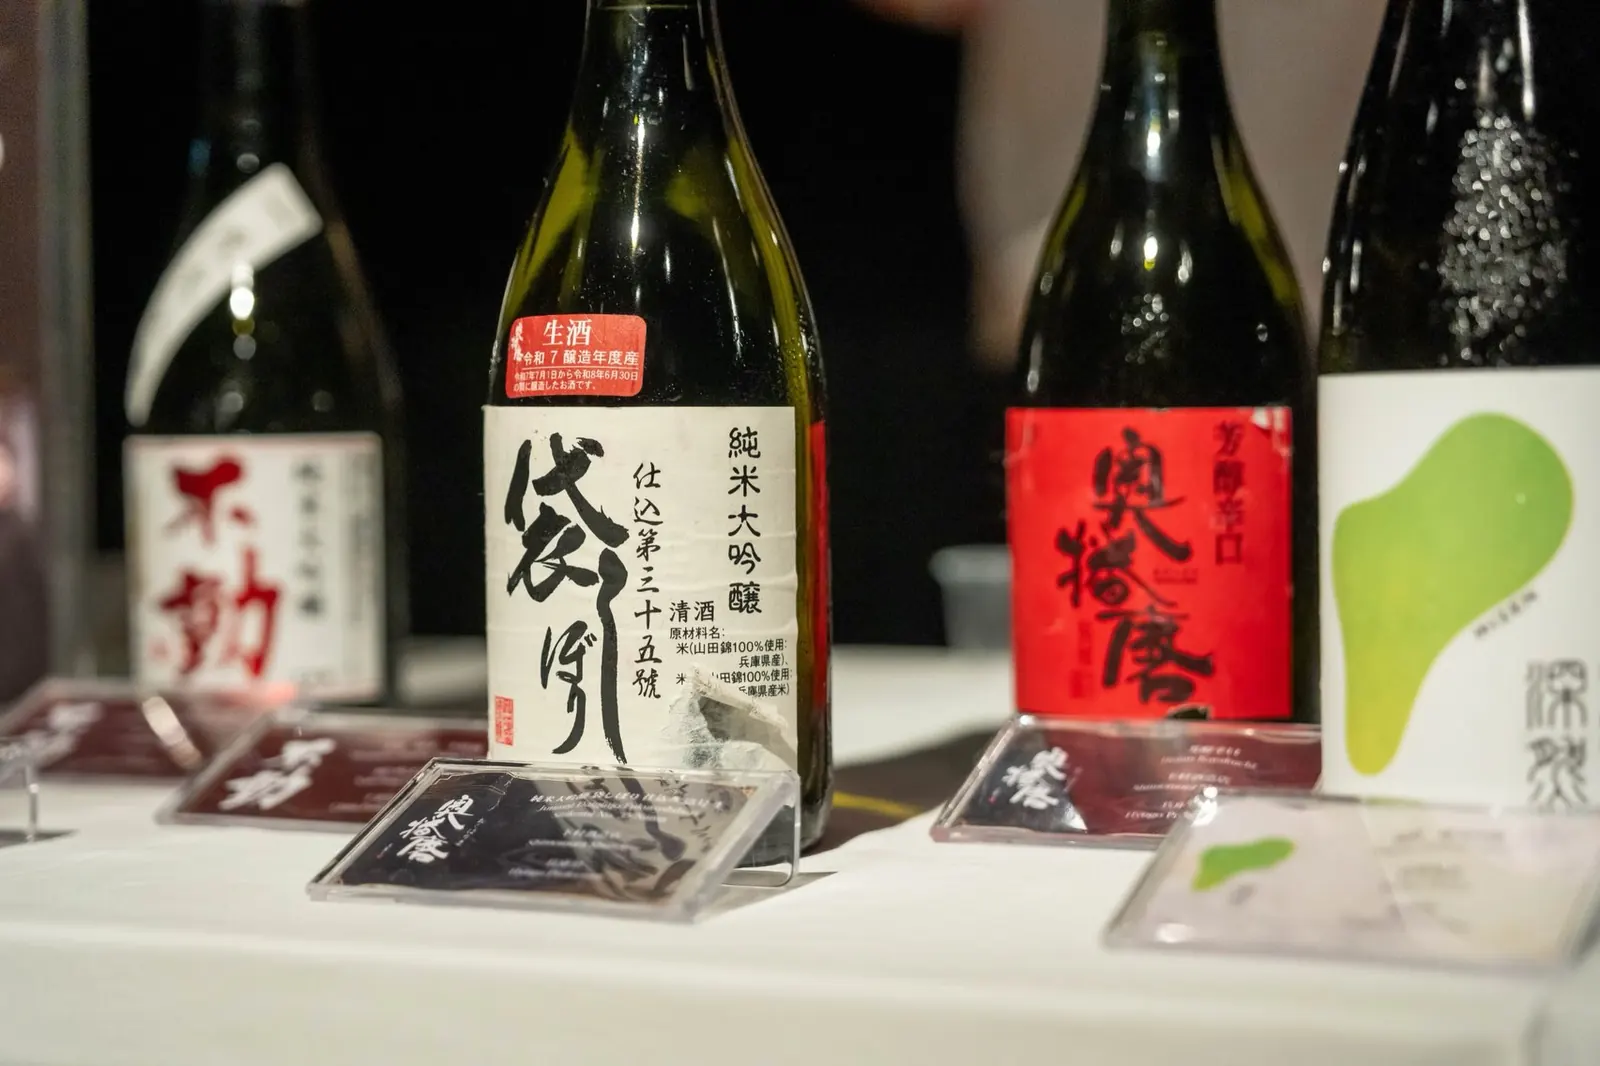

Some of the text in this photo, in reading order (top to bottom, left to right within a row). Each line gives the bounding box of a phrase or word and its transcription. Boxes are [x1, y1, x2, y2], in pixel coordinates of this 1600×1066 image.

[542, 319, 592, 346] 生酒
[728, 426, 762, 614] 純米大吟醸
[632, 462, 663, 699] 仕込第三十五號
[669, 599, 715, 623] 清酒
